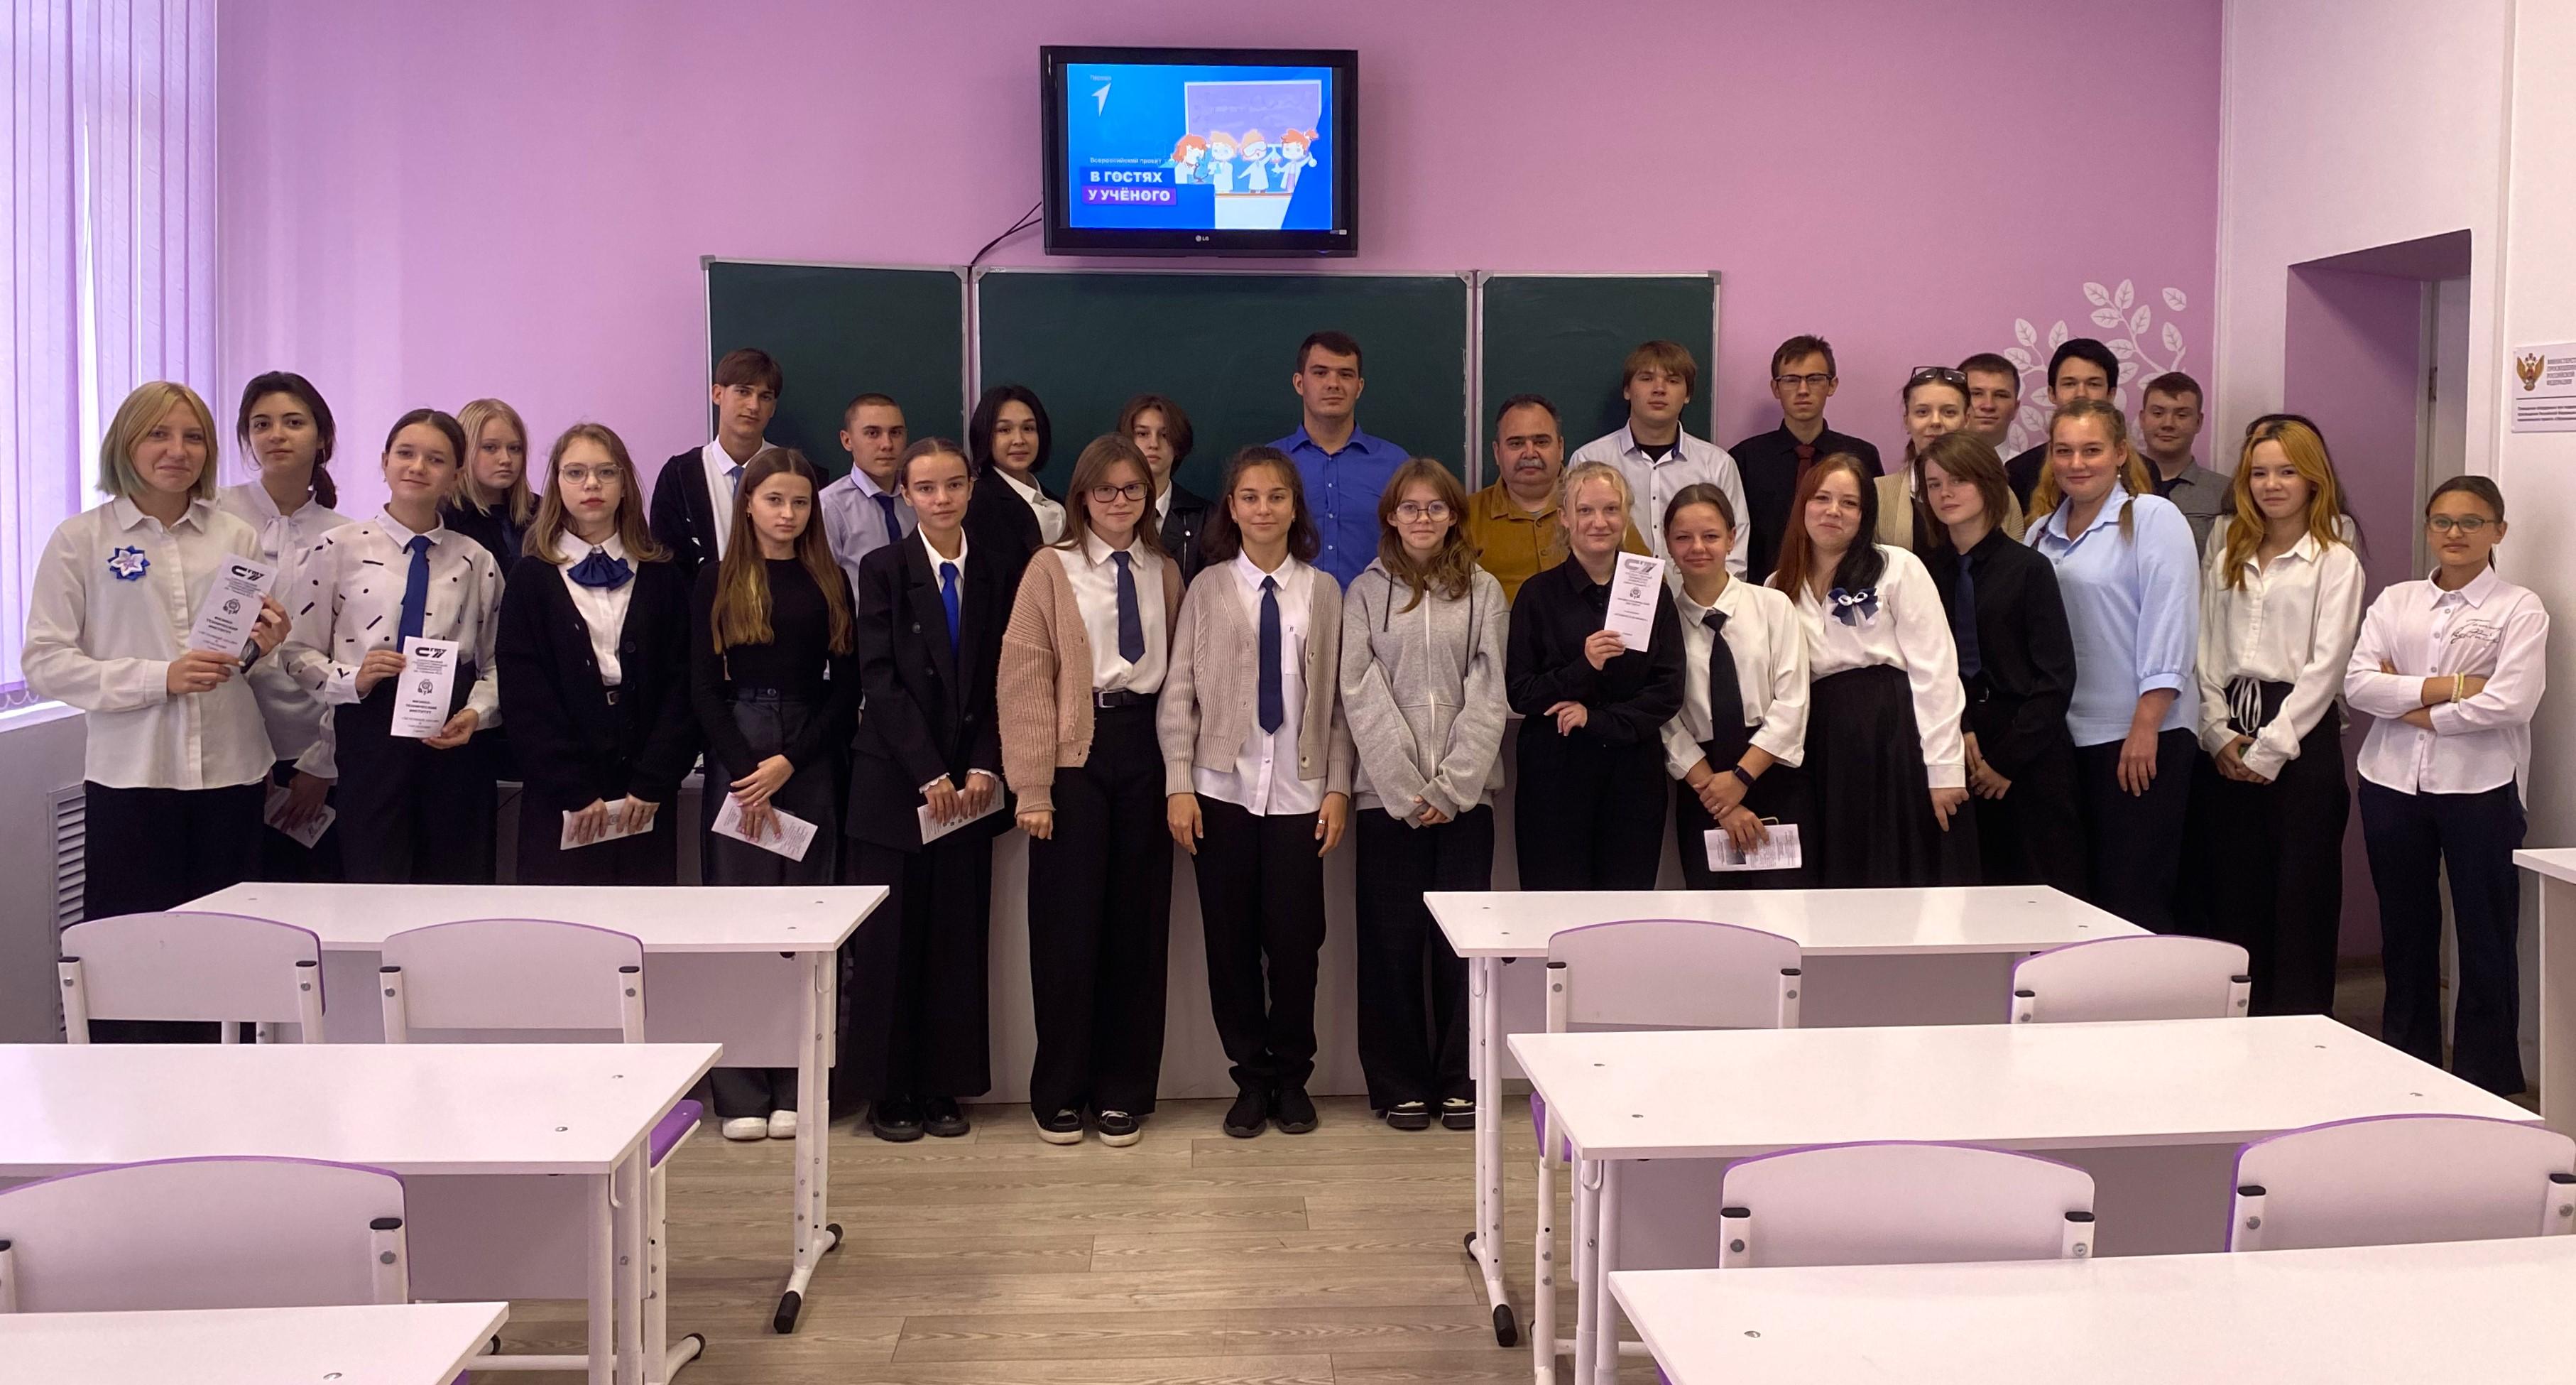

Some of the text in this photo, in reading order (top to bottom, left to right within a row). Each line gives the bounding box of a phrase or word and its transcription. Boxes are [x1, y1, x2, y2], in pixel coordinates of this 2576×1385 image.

[1090, 170, 1162, 183] В ГОСТЯХ
[1088, 187, 1171, 201] У УЧЁНОГО
